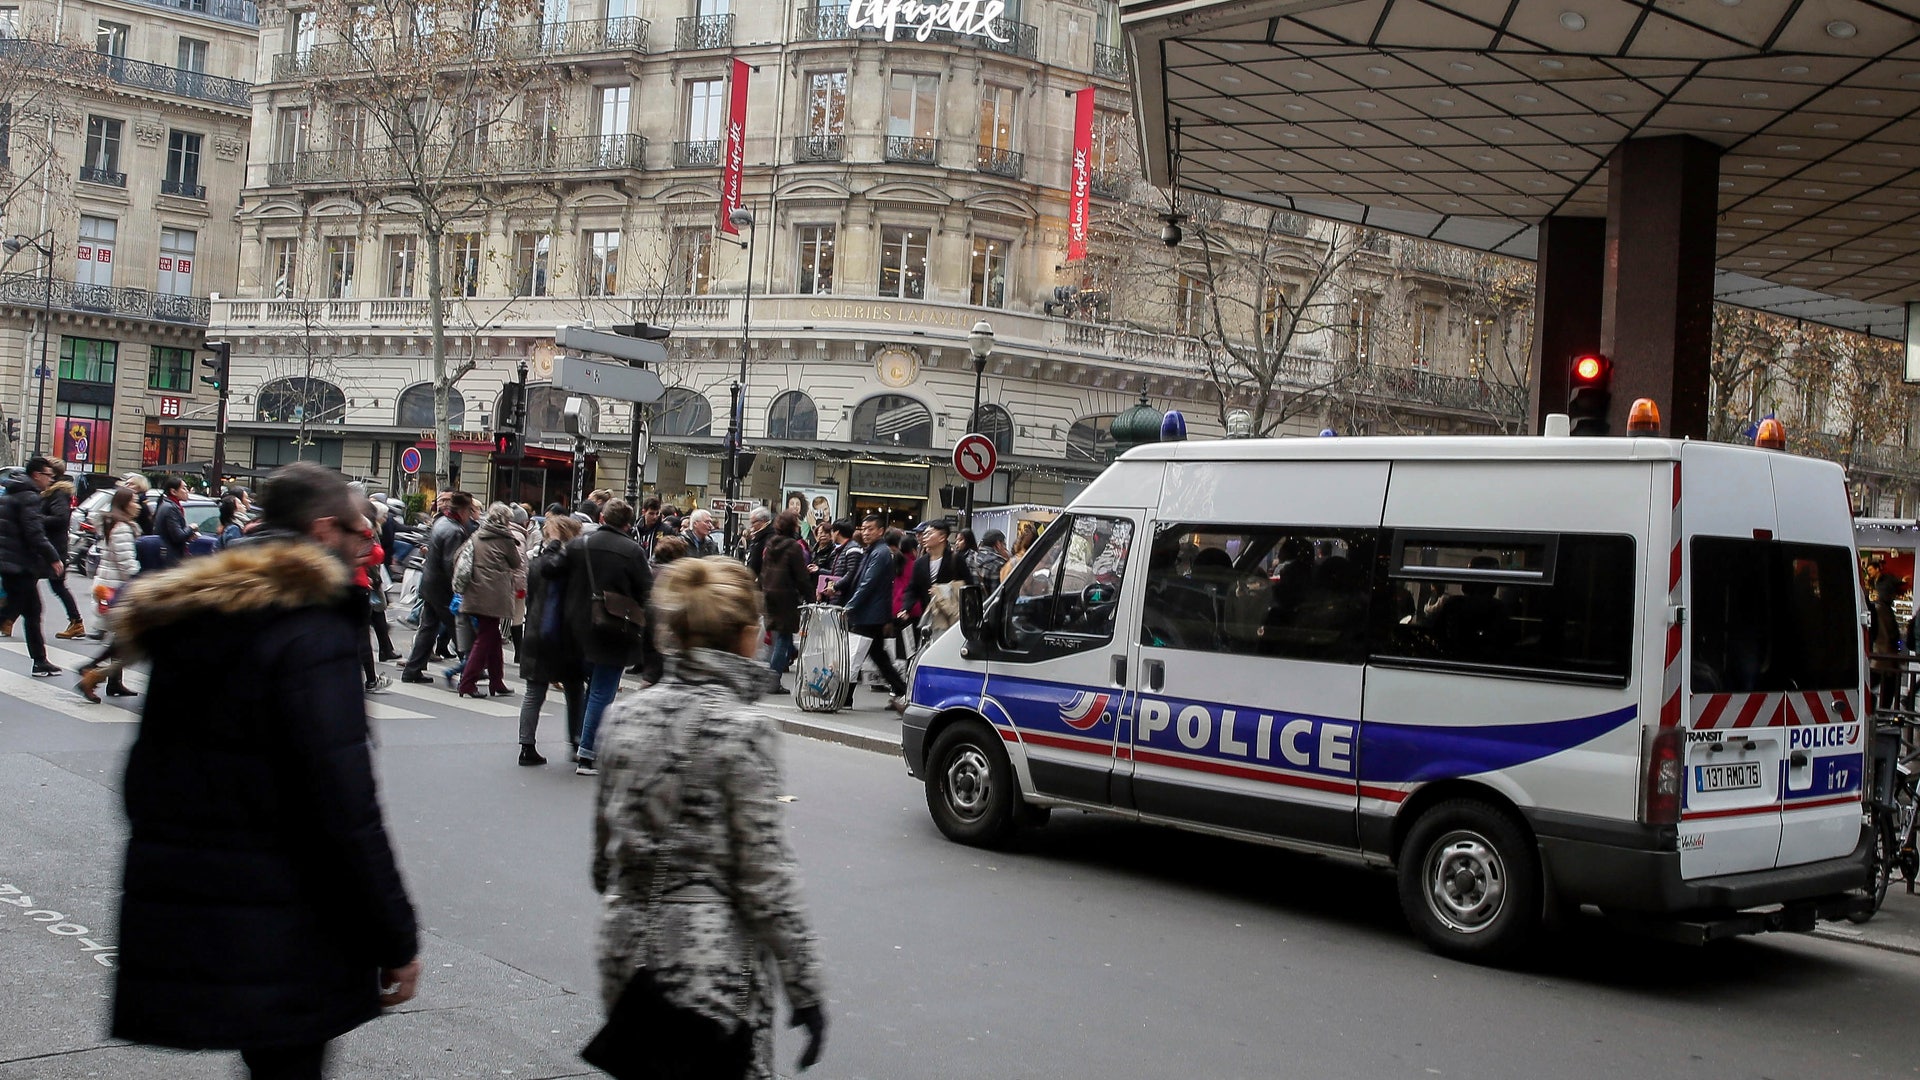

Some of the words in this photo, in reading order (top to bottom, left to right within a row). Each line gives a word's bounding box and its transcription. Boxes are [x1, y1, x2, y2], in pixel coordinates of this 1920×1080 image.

[1074, 147, 1087, 198] Lafayette
[810, 303, 892, 320] GALERIES
[1043, 637, 1082, 648] TRANSIT
[1138, 698, 1353, 772] POLICE
[1686, 731, 1723, 742] TRANSIT
[1790, 725, 1844, 750] POLICE
[1706, 768, 1723, 788] 137
[1746, 765, 1759, 785] 75
[1835, 769, 1848, 789] 17
